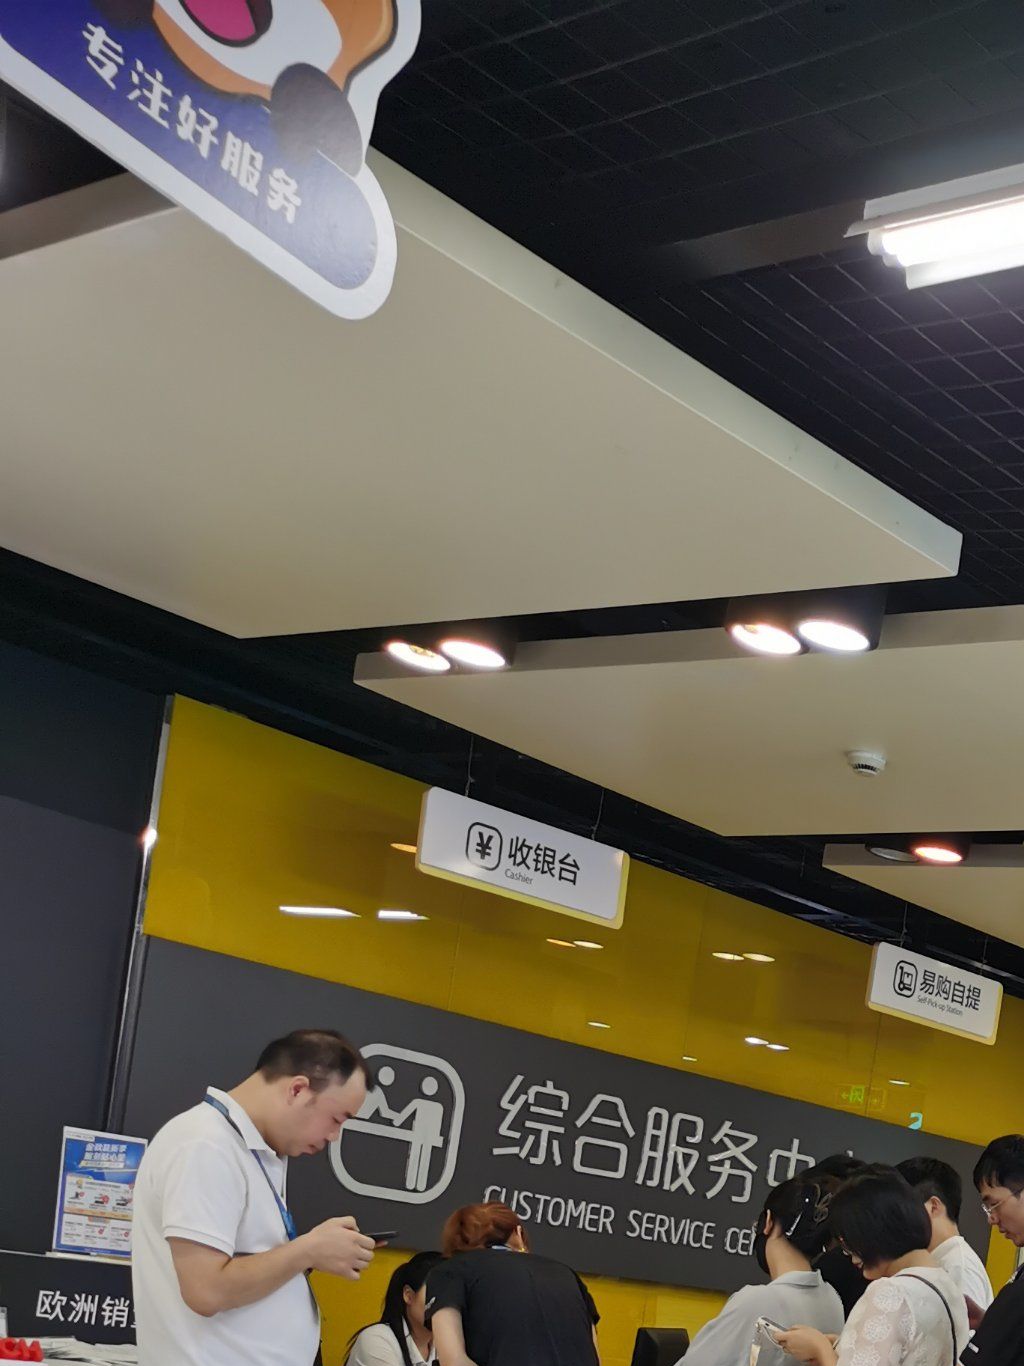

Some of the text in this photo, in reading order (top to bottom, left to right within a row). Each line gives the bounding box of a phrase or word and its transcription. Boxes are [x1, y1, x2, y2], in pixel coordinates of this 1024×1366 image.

[82, 22, 302, 224] 专注好服务
[504, 868, 533, 885] Cashier
[508, 836, 580, 886] 收银台
[919, 969, 982, 1011] 易购自提
[492, 1074, 853, 1203] 综合服务中
[626, 1209, 716, 1250] SERVICE
[36, 1290, 137, 1328] 欧洲销
